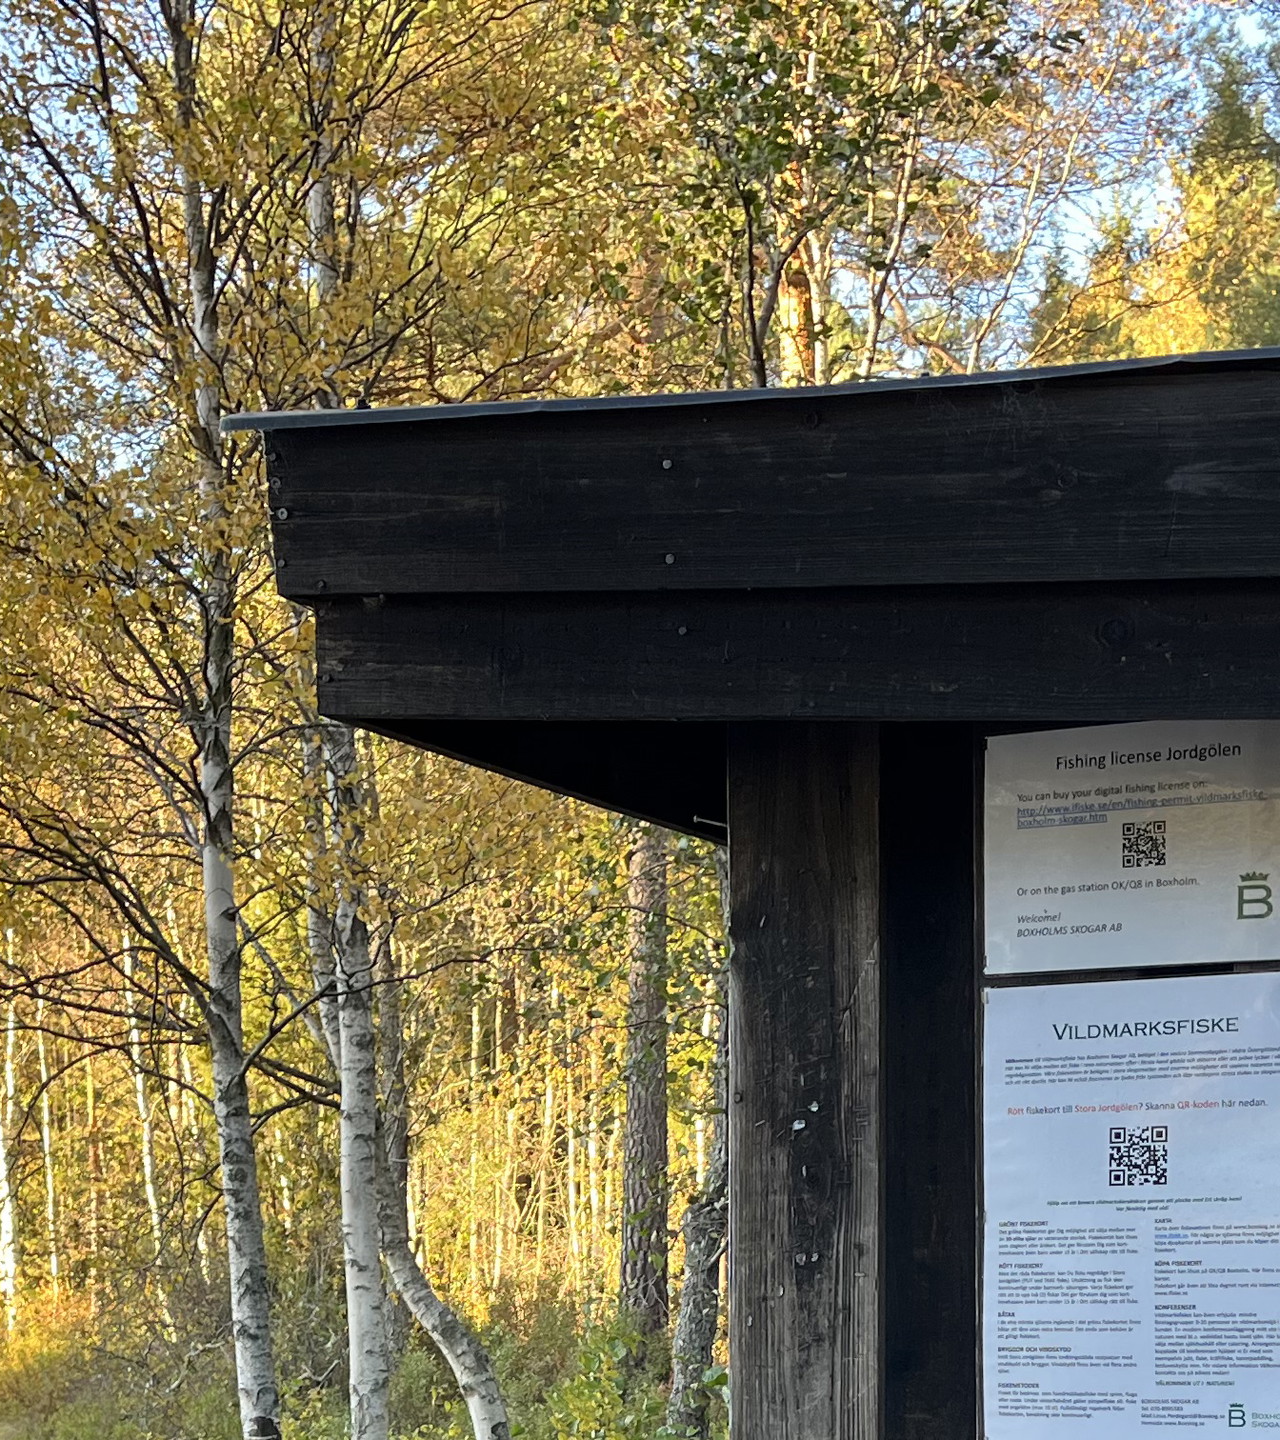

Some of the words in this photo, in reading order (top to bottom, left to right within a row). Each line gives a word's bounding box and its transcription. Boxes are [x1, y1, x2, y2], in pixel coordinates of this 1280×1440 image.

[1056, 754, 1106, 769] Fishing
[1110, 751, 1161, 764] license
[1166, 743, 1240, 760] Jordgölen
[1016, 793, 1032, 802] You
[1052, 790, 1069, 799] buy
[1071, 789, 1092, 799] your
[1094, 785, 1122, 797] digital
[1125, 784, 1155, 793] fishing
[1157, 781, 1190, 790] license
[1016, 887, 1027, 896] Or
[1043, 885, 1058, 894] the
[1060, 885, 1075, 895] gas
[1077, 883, 1109, 892] station
[1111, 879, 1142, 890] OK/Q8
[1016, 926, 1067, 937] BOXHOLMS
[1070, 923, 1107, 934] SKOGAR
[1108, 922, 1122, 931] AB
[1052, 1017, 1238, 1039] VILDMARKSFISKE
[1025, 1106, 1060, 1114] fiskekort
[1098, 1101, 1143, 1112] Jordgölen?
[1145, 1101, 1175, 1110] Skanna
[1176, 1099, 1219, 1110] QR-koden
